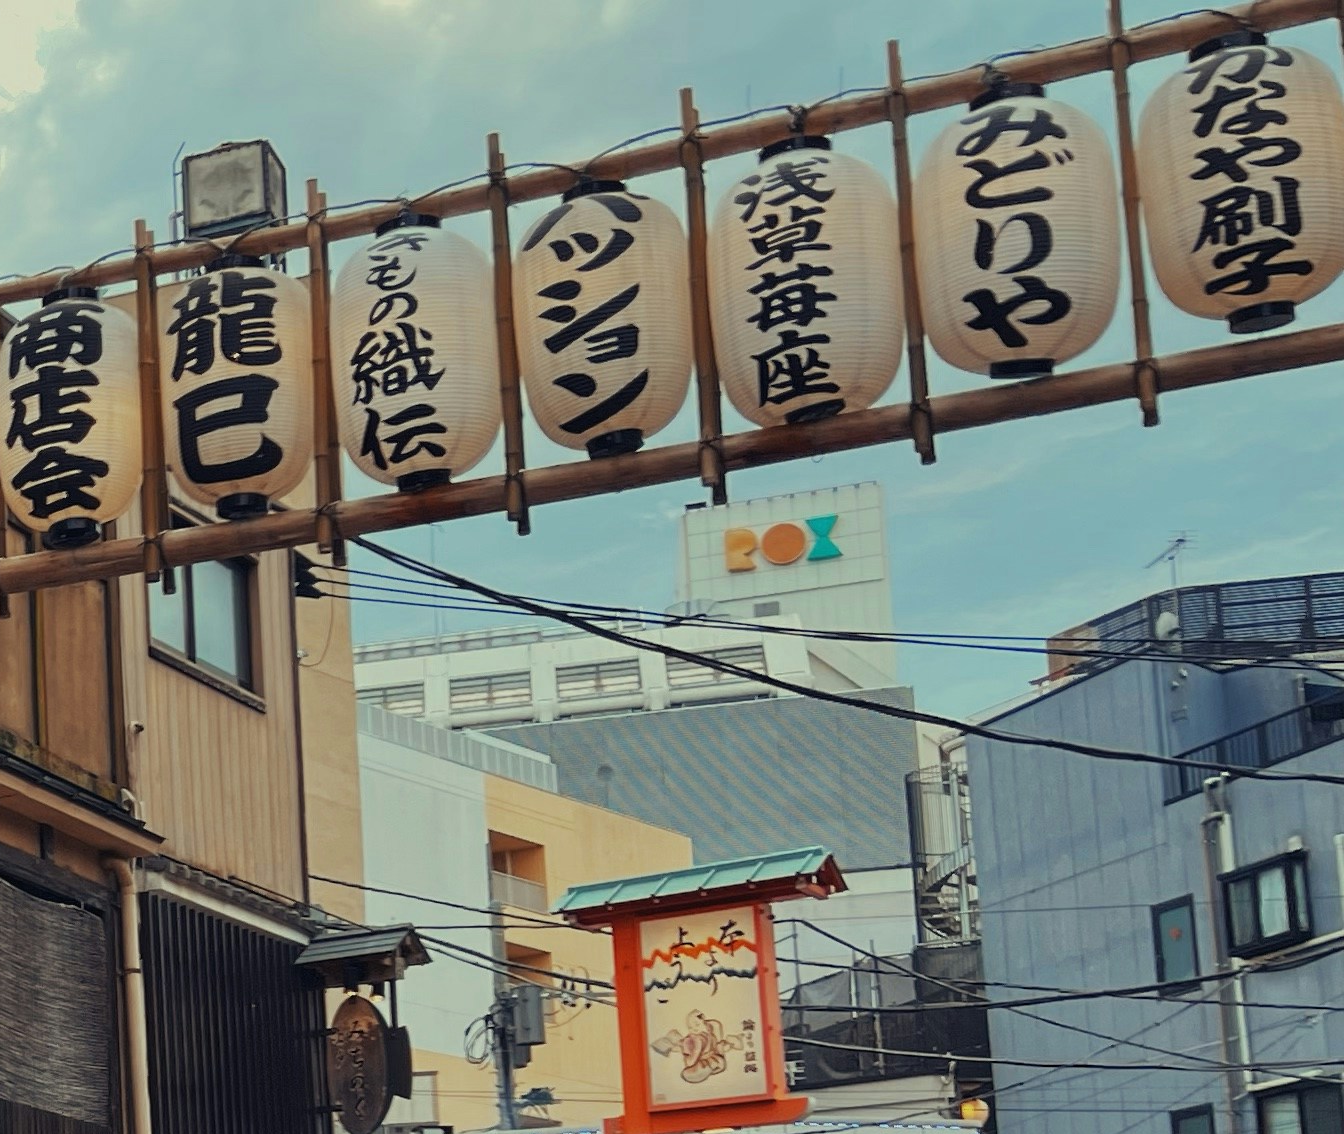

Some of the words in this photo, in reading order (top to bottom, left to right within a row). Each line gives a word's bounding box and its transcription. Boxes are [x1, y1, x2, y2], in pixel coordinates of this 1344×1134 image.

[734, 156, 841, 408] 浅草苺座
[956, 106, 1074, 348] みどりや
[1185, 47, 1314, 295] かなや刷子
[6, 300, 109, 519] 商店会
[167, 271, 284, 484] 龍巳
[351, 231, 447, 470] きもの織伝
[724, 514, 843, 573] ROX
